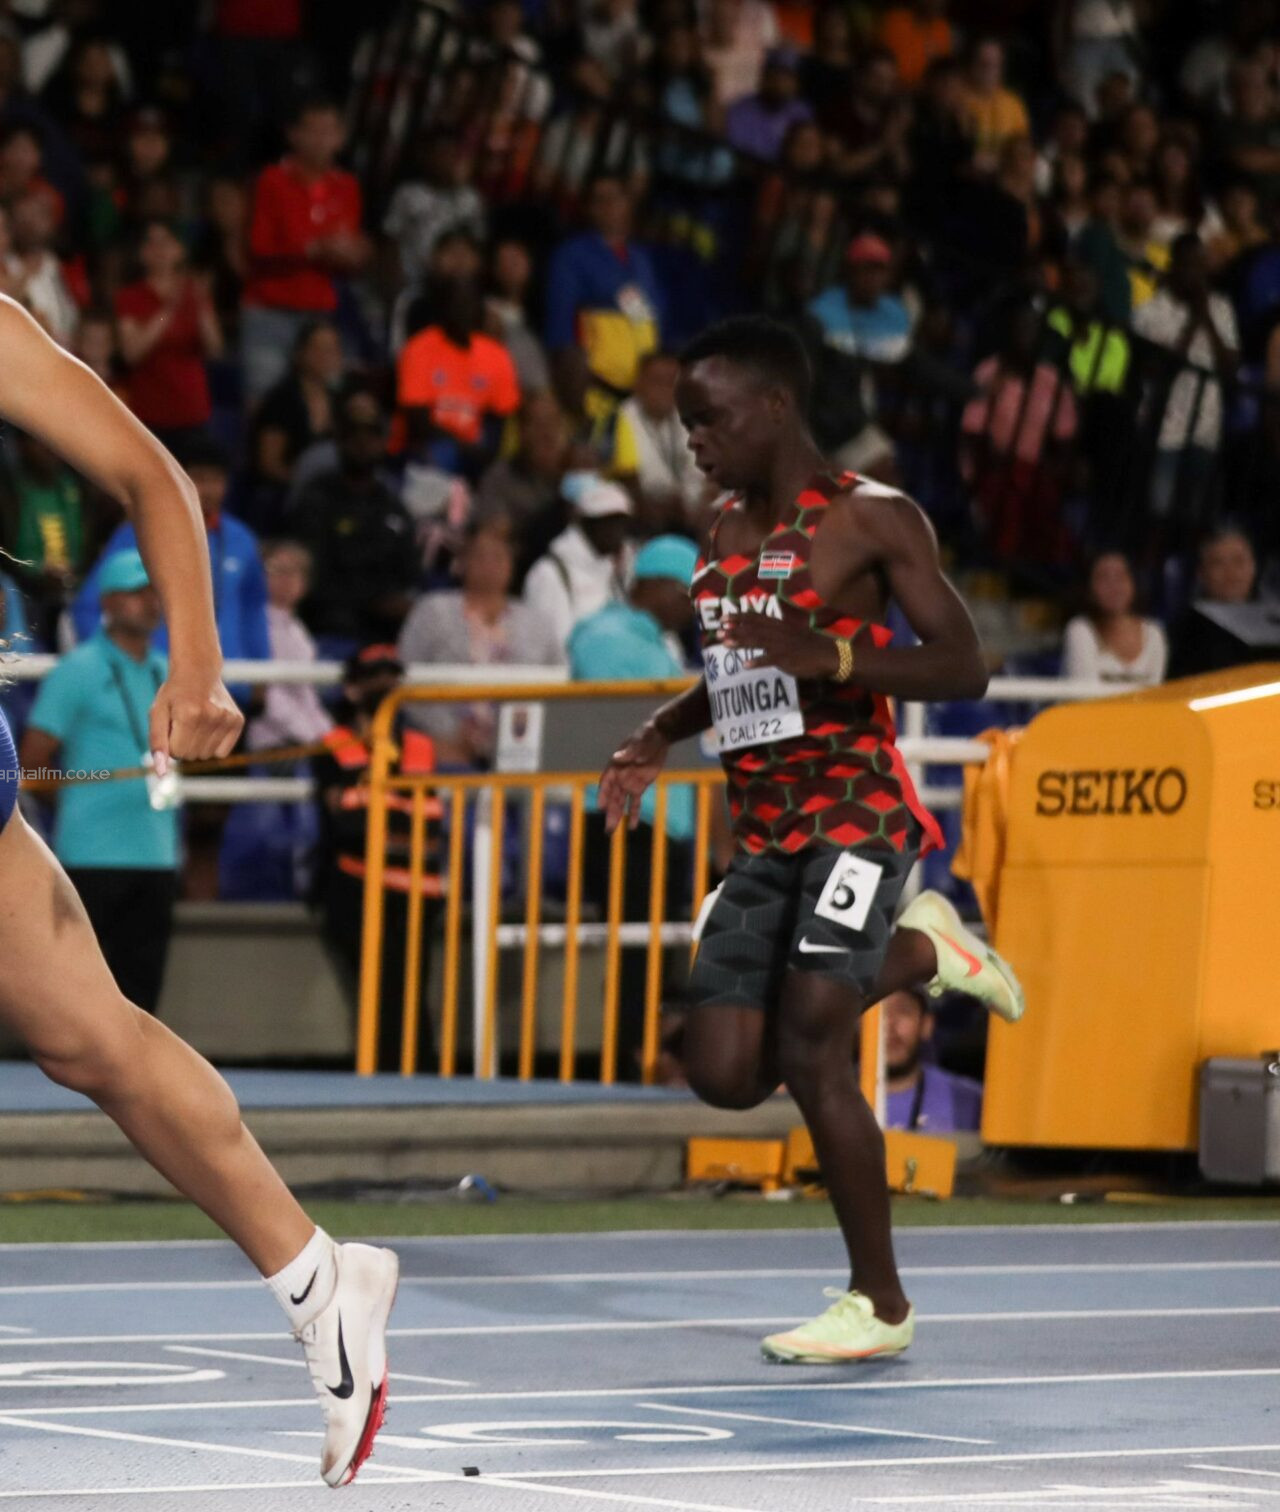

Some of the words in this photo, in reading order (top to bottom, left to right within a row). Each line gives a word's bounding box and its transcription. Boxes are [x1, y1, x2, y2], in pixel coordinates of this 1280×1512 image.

[713, 677, 790, 721] UTUNGA
[729, 723, 757, 744] CALI
[760, 718, 783, 737] 22
[1035, 767, 1188, 817] SEIKO
